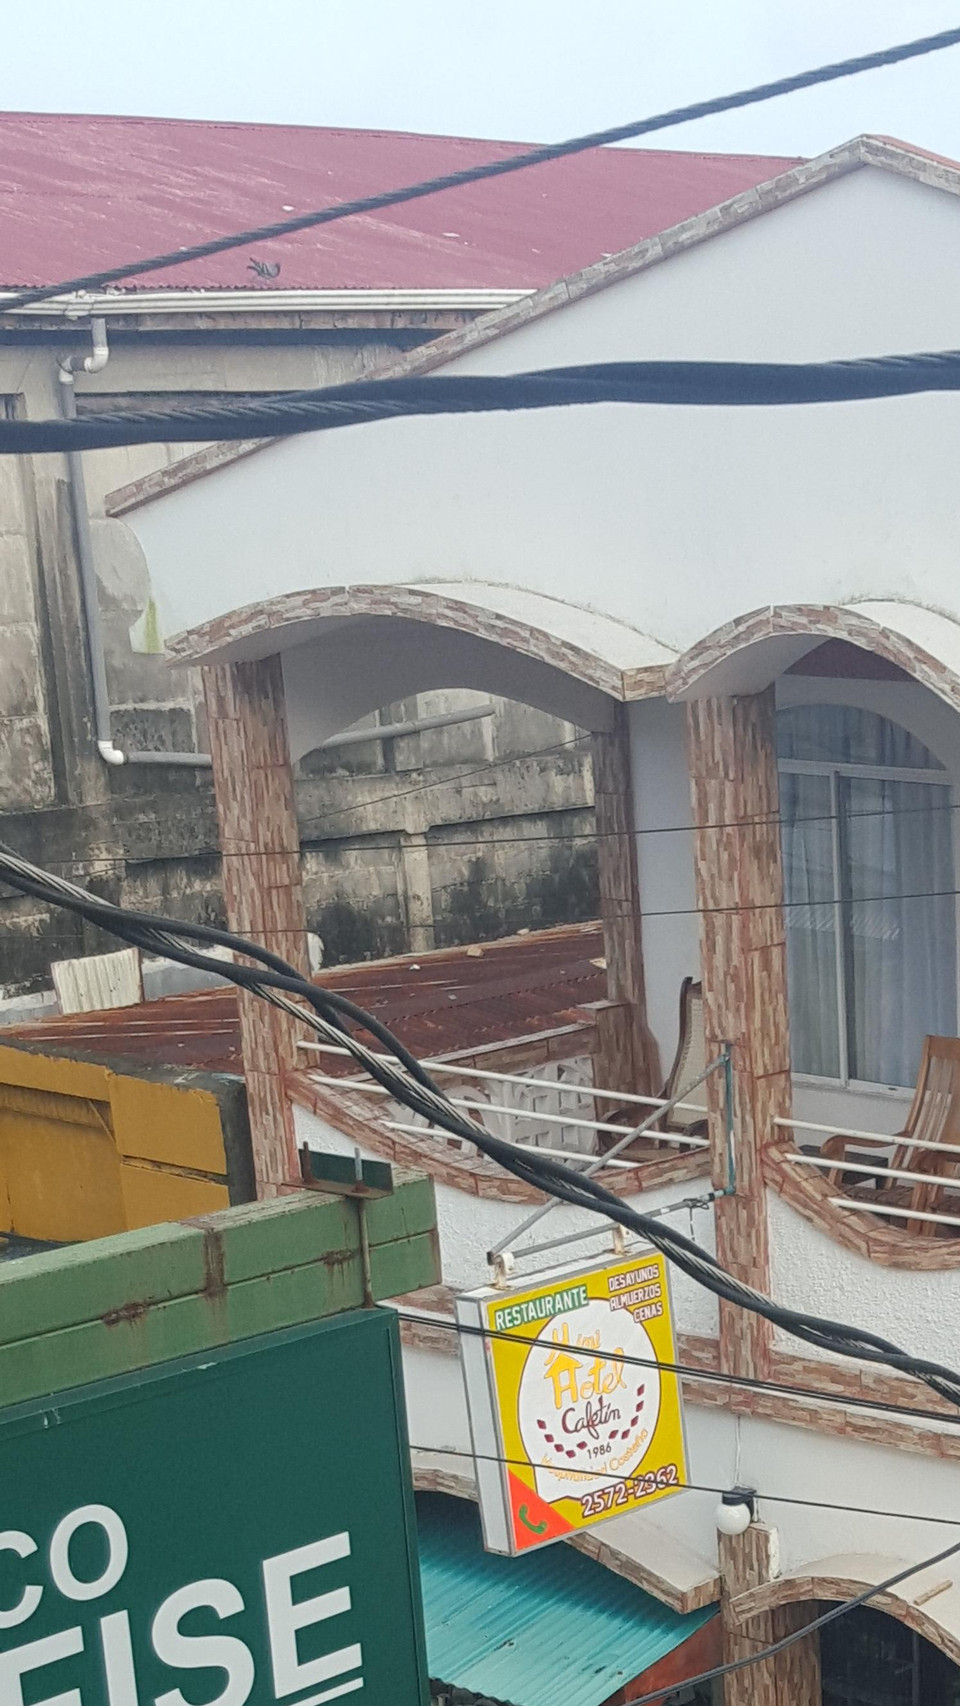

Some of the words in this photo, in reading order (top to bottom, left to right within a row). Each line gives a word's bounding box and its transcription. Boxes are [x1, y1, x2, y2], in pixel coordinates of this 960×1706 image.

[608, 1264, 660, 1291] DESAYUNOS
[494, 1286, 588, 1331] RESTAURANTE
[609, 1283, 661, 1311] ALMUERZOS
[633, 1301, 663, 1323] CENAS
[544, 1347, 627, 1410] Hotel
[561, 1395, 622, 1440] Cafetín
[587, 1442, 612, 1460] 1986
